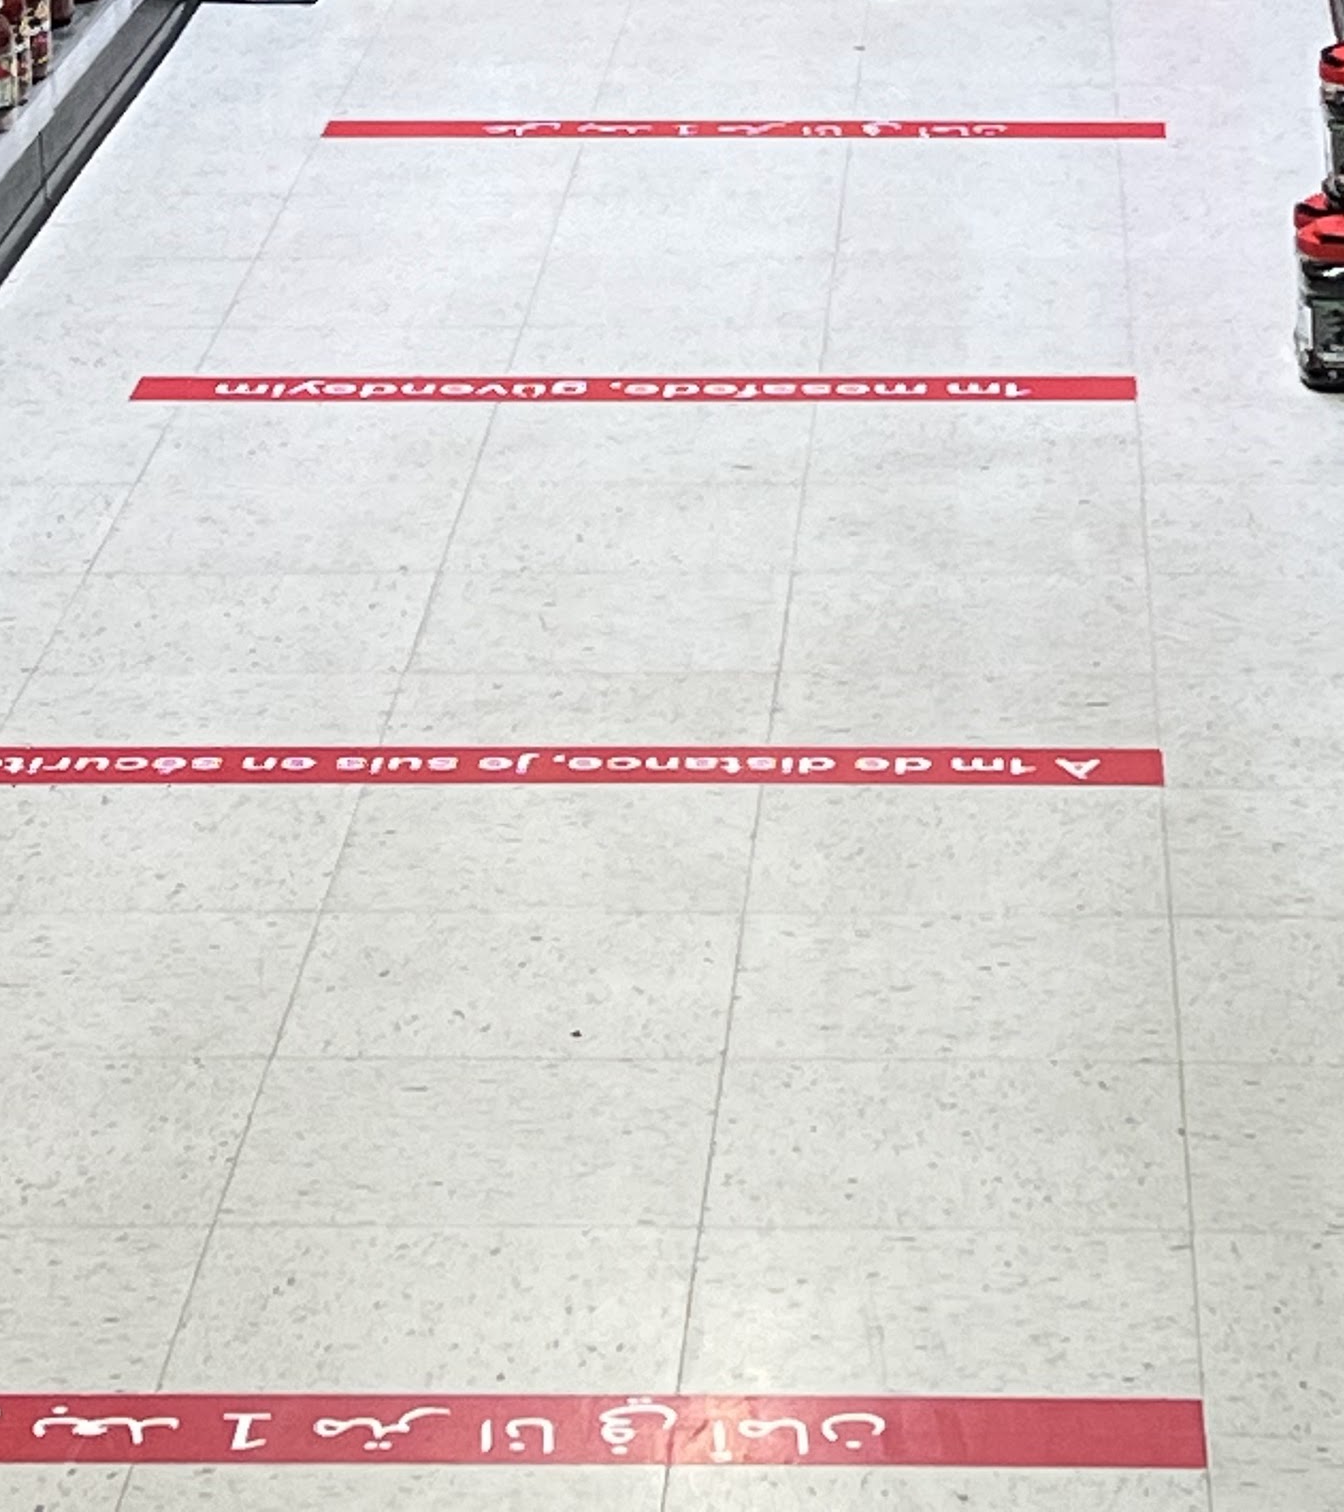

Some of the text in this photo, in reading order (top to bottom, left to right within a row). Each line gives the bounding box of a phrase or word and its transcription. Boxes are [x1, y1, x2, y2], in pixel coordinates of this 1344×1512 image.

[242, 756, 317, 772] en
[336, 756, 459, 775] suis
[478, 753, 540, 776] je
[854, 757, 932, 776] de
[951, 757, 1036, 776] 1m
[33, 1406, 179, 1445] بعد
[223, 1413, 274, 1450] 1
[313, 1406, 451, 1450] متر
[599, 1397, 680, 1456] في
